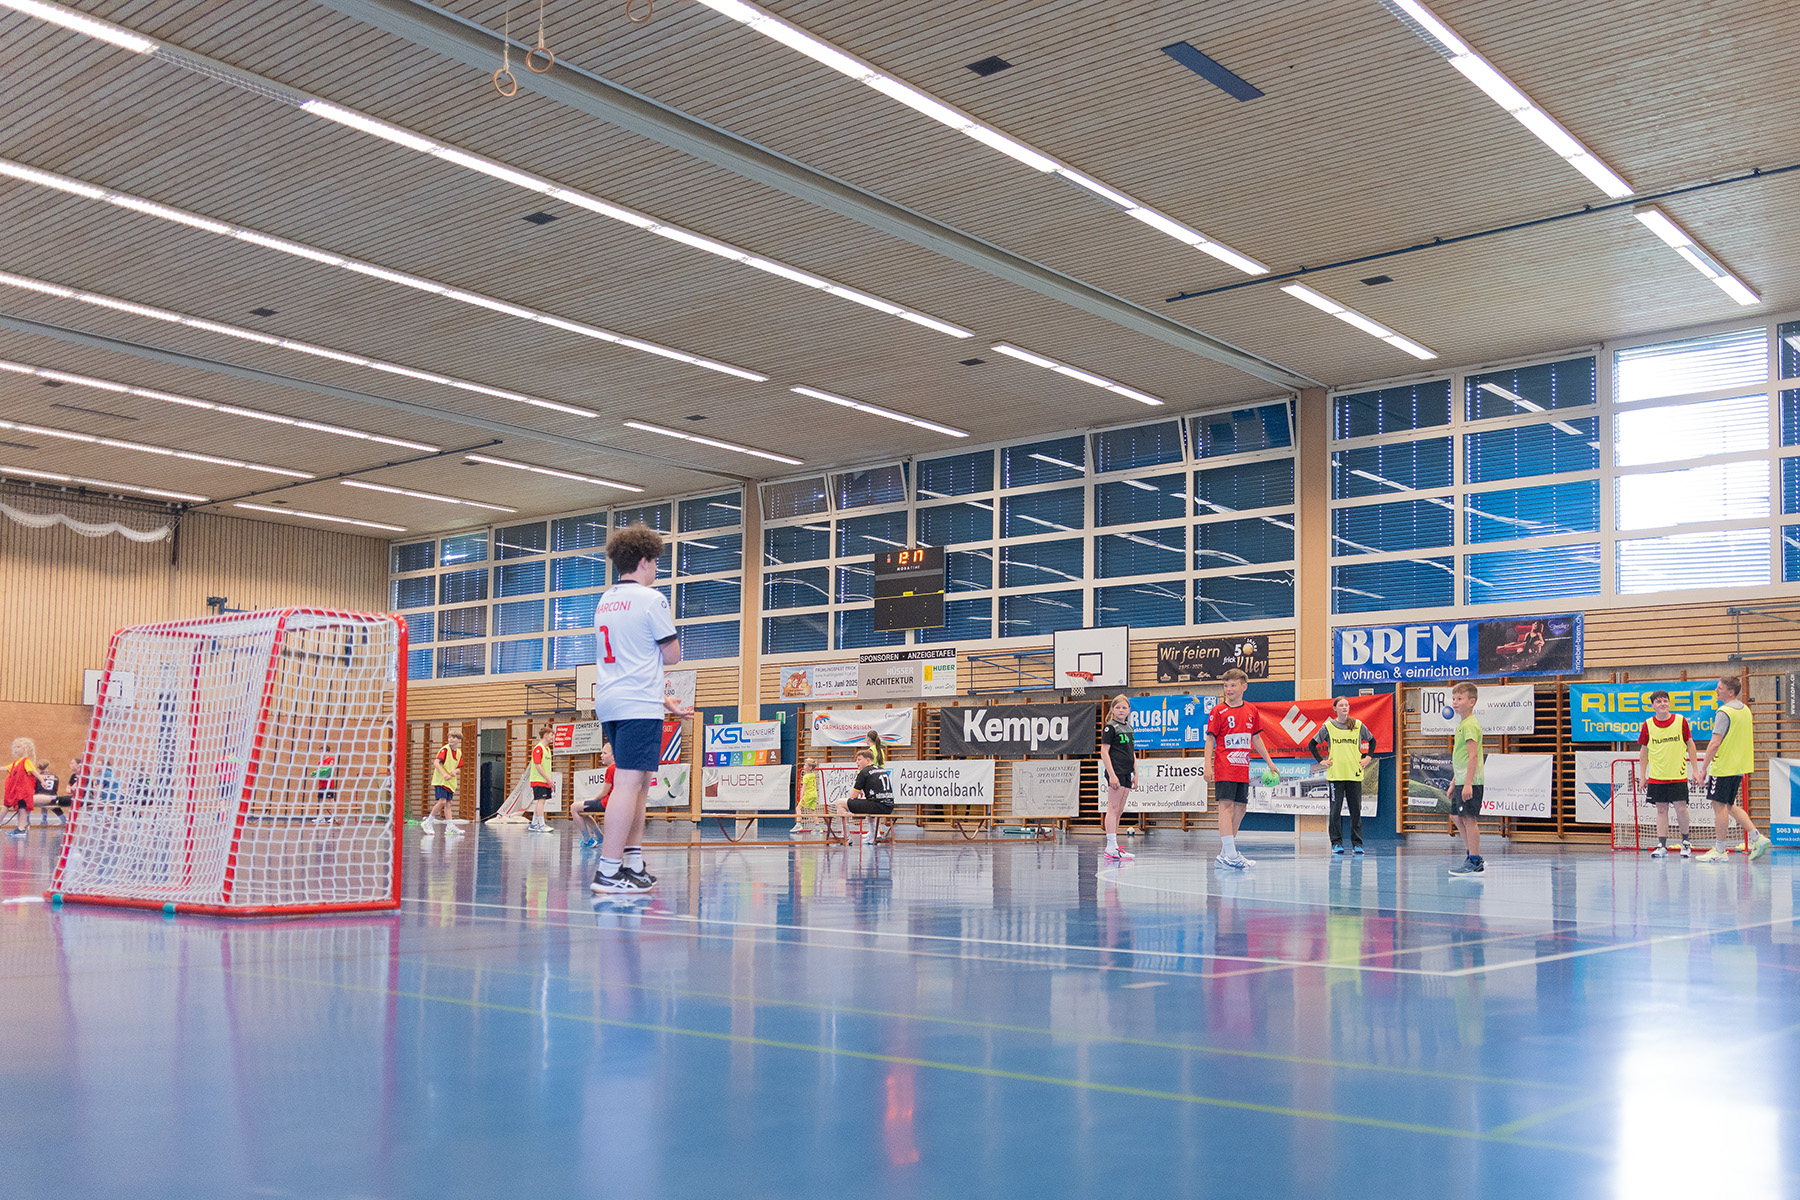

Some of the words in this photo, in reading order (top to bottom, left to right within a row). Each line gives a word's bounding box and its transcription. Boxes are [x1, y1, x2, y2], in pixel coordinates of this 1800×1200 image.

[599, 625, 616, 664] 1
[1341, 623, 1469, 665] BREM
[860, 653, 899, 663] SPONSOREN
[907, 649, 956, 659] ANZEIGETAFEL
[1160, 647, 1180, 660] Wir
[1180, 646, 1220, 664] feiern
[886, 666, 914, 676] HÜSSER
[1342, 668, 1390, 680] wohnen
[1393, 666, 1402, 679] &
[1405, 665, 1469, 678] einrichten
[866, 676, 914, 686] ARCHITEKTUR
[1487, 700, 1533, 708] www.uta.ch
[1129, 709, 1179, 727] RUBIN
[1227, 715, 1236, 728] 8
[963, 709, 1069, 751] Kempa
[1582, 718, 1642, 735] Transpor
[711, 727, 750, 745] KSL
[1119, 734, 1130, 744] 14
[1651, 735, 1681, 745] hummel
[900, 767, 960, 781] Aargauische
[1156, 764, 1205, 778] Fitness
[1281, 766, 1294, 775] Jud
[1294, 766, 1307, 774] AG
[588, 774, 605, 785] HUS
[721, 774, 764, 786] HUBER
[900, 782, 984, 797] Kantonalbank
[1146, 783, 1167, 794] jeder
[1169, 783, 1186, 792] Zeit
[1142, 800, 1205, 808] www.budgetfitness.ch
[1480, 800, 1495, 810] VS
[1496, 801, 1530, 811] Müller
[1531, 802, 1546, 812] AG
